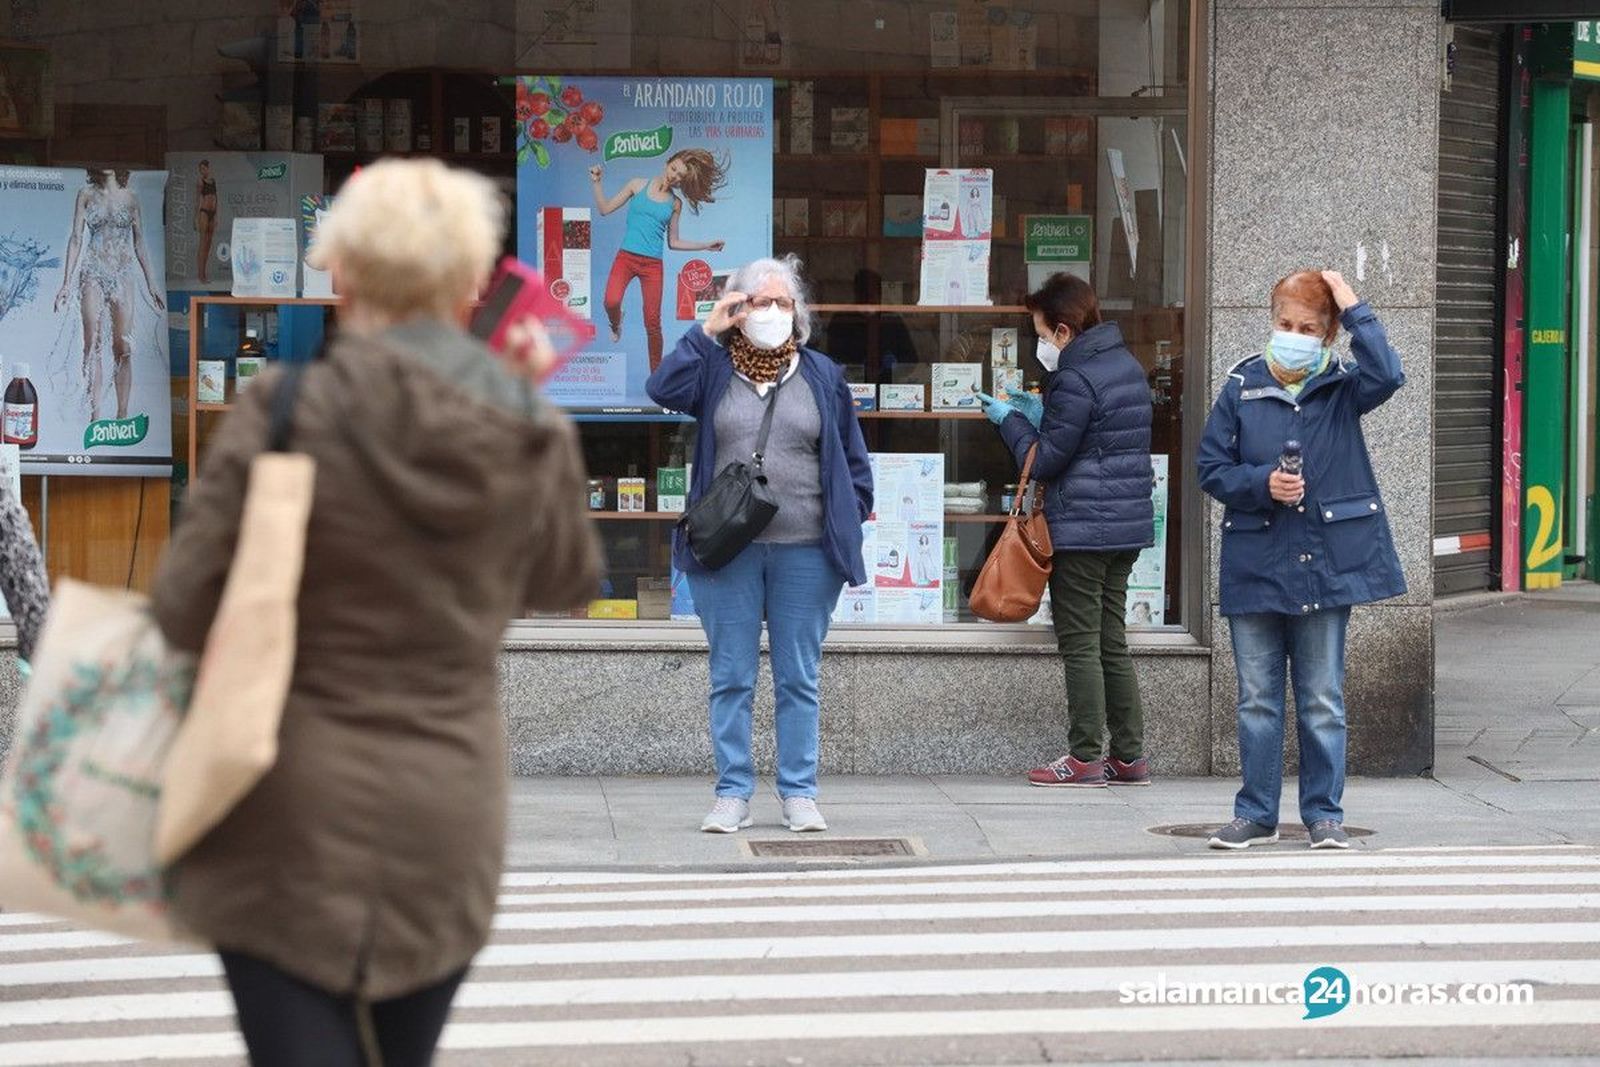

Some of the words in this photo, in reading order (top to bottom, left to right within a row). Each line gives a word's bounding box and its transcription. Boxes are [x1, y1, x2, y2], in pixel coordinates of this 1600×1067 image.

[1577, 20, 1590, 42] DE
[634, 78, 716, 108] ARÁNDANO
[723, 83, 764, 108] ROJO
[610, 131, 663, 155] Santiveri
[89, 420, 139, 443] Santiveri
